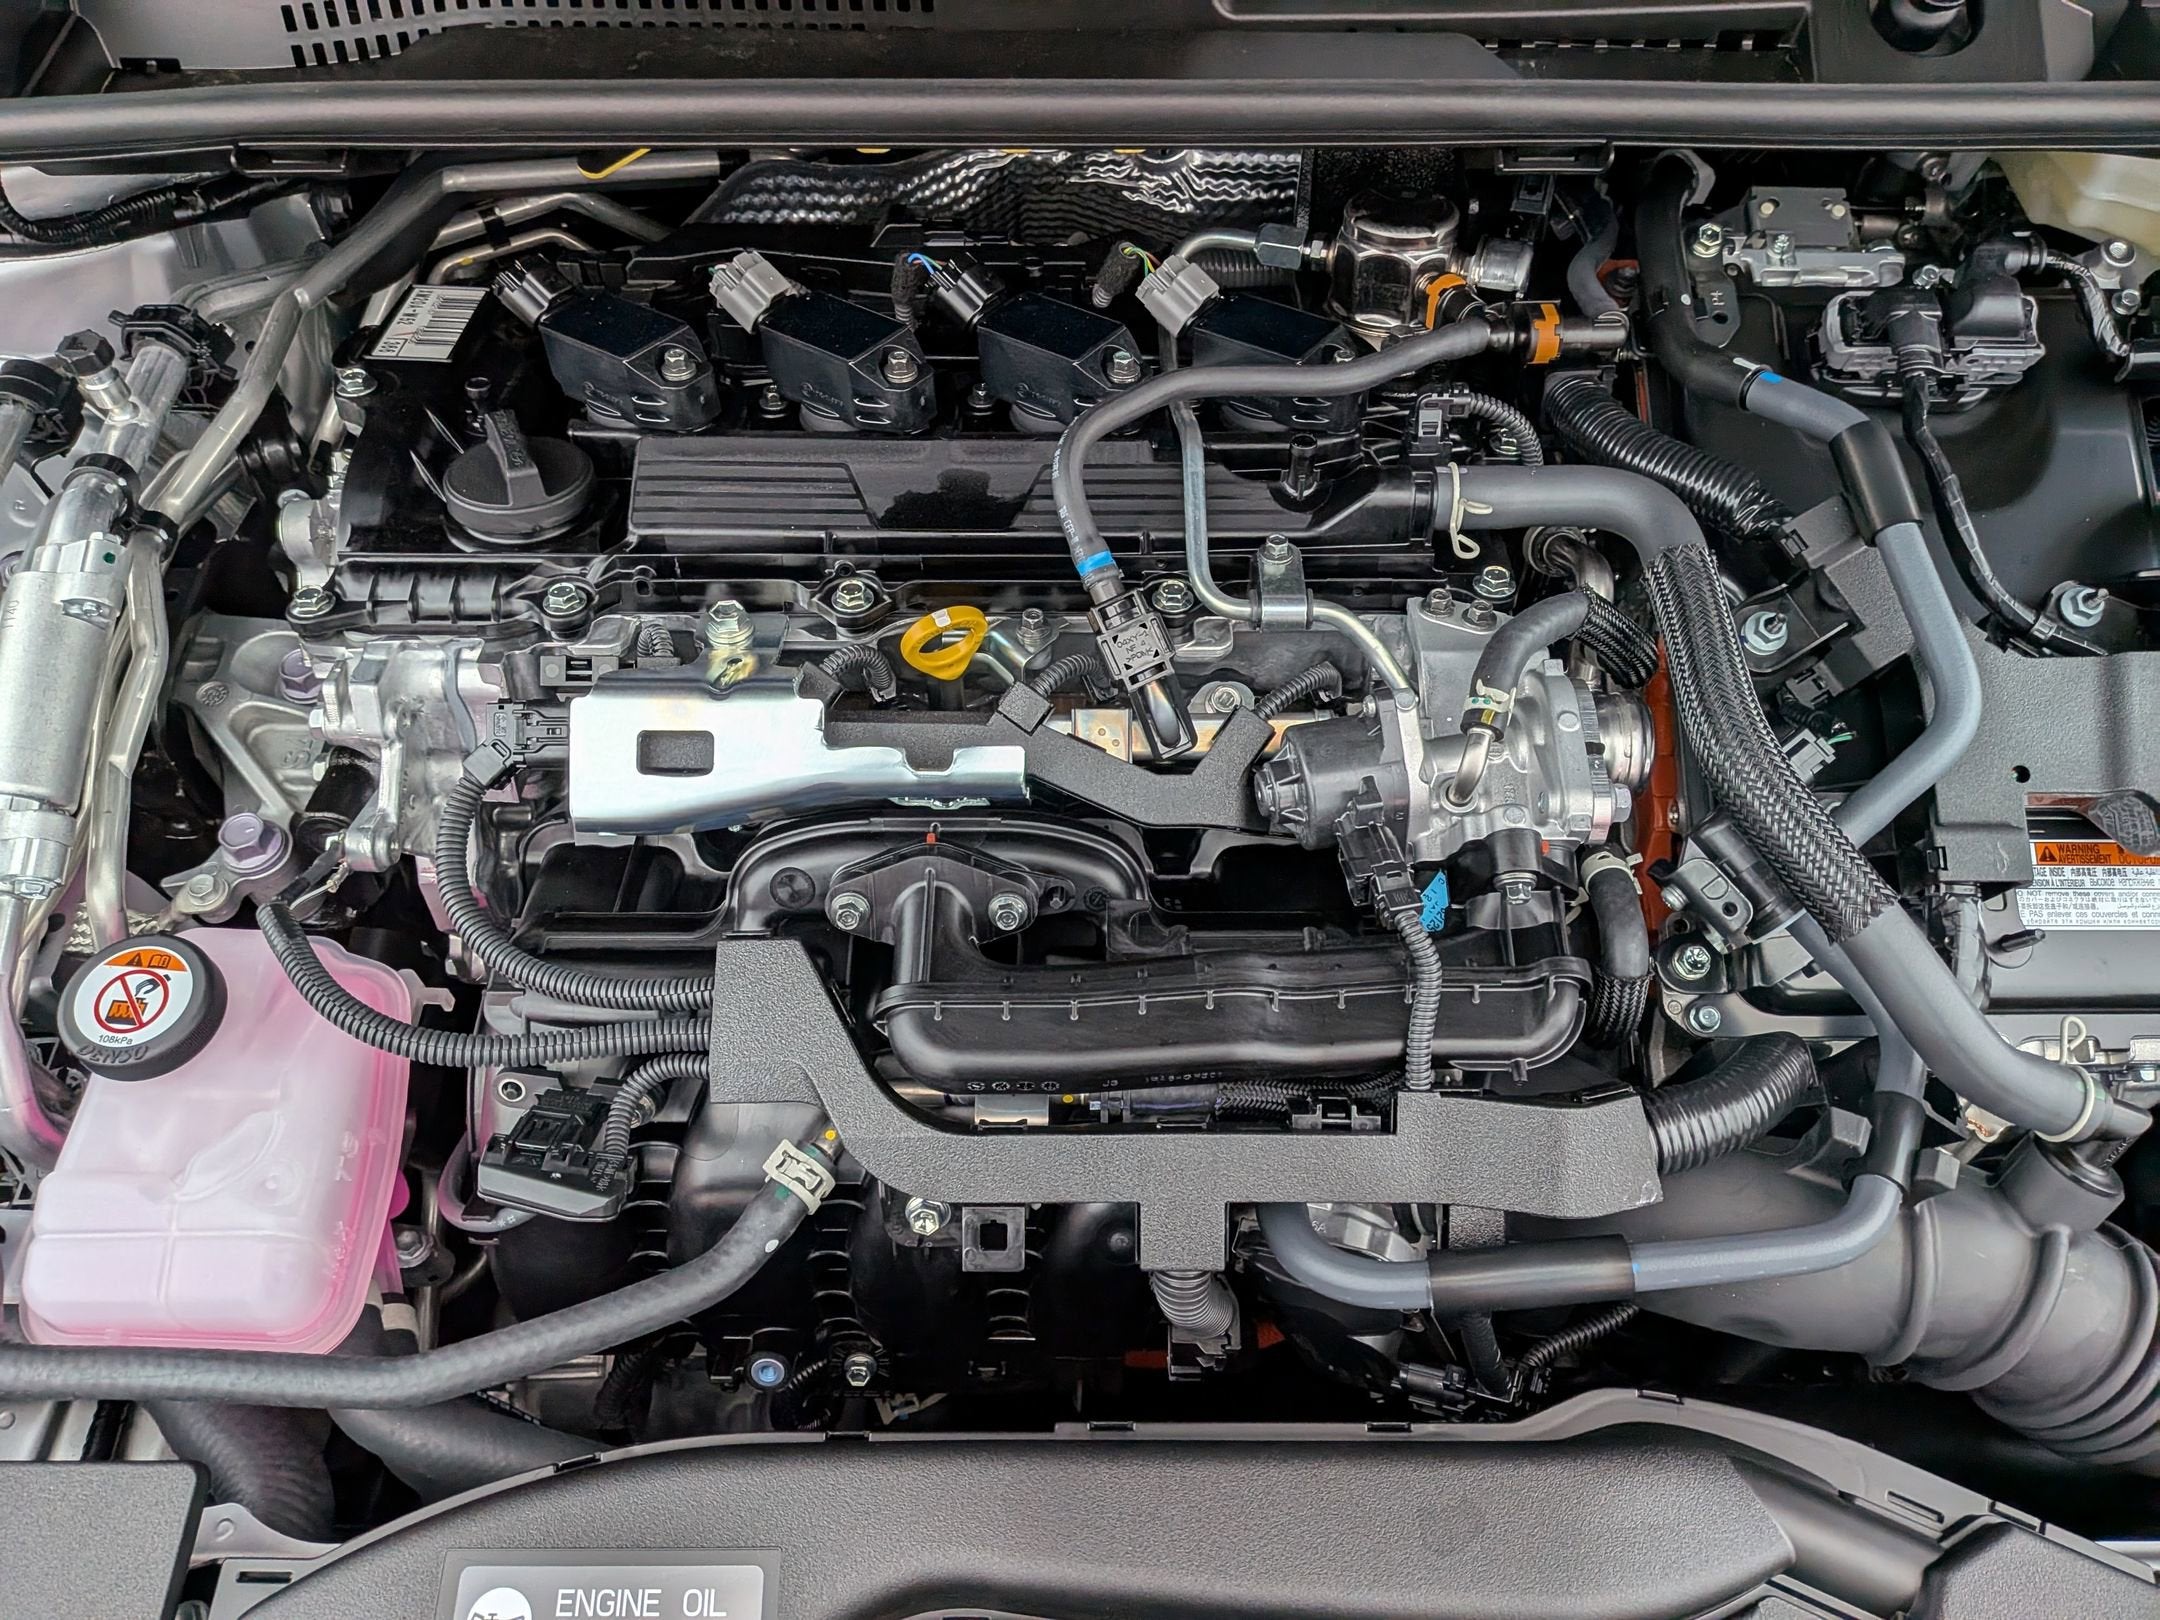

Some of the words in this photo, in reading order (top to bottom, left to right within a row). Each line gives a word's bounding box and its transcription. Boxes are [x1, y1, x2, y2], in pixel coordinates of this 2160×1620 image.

[2056, 843, 2100, 854] WARNING
[2059, 854, 2111, 864] AVERTISSEMENT
[2049, 867, 2066, 877] INSIDE
[2029, 910, 2044, 918] PAS
[98, 1034, 133, 1045] 108kPa
[77, 1044, 149, 1064] DENSO
[554, 1588, 662, 1618] ENGINE
[682, 1588, 727, 1618] OIL
